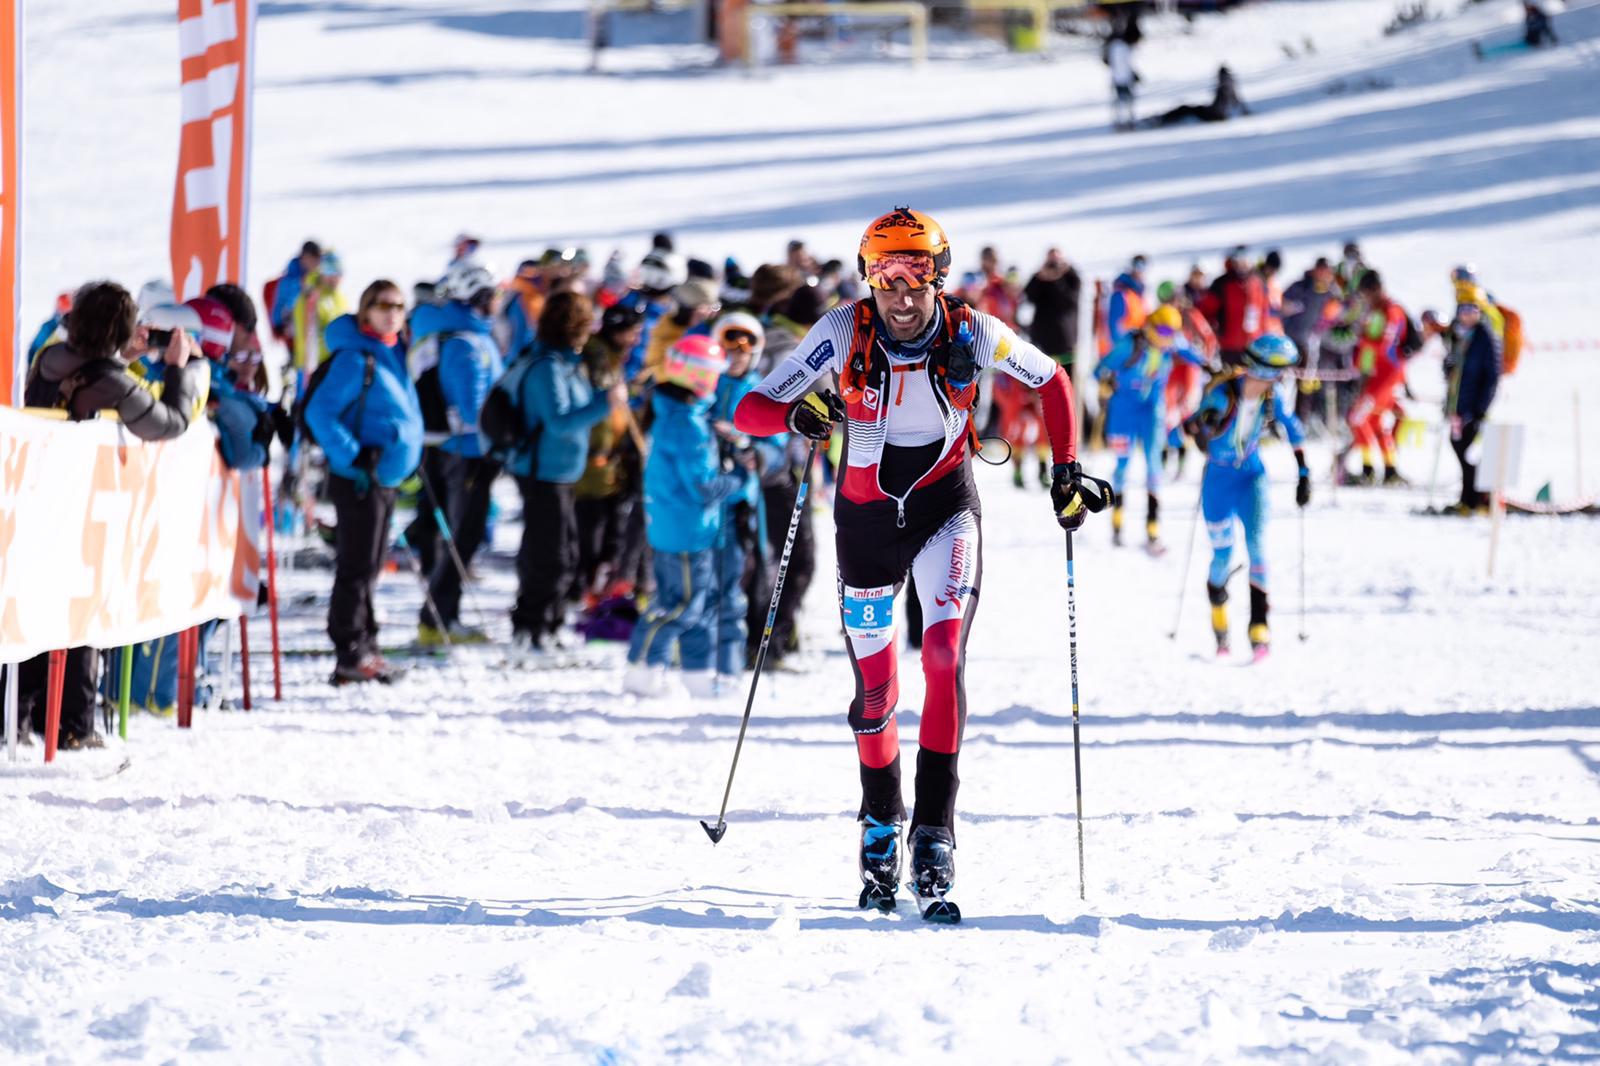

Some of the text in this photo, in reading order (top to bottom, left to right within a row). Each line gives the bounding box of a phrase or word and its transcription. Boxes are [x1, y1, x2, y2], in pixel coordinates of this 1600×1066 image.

[875, 219, 924, 231] adidas
[1005, 357, 1036, 381] MARTINI
[772, 369, 806, 394] Lenzing
[935, 537, 966, 613] SKI AUSTRIA
[863, 604, 875, 622] 8
